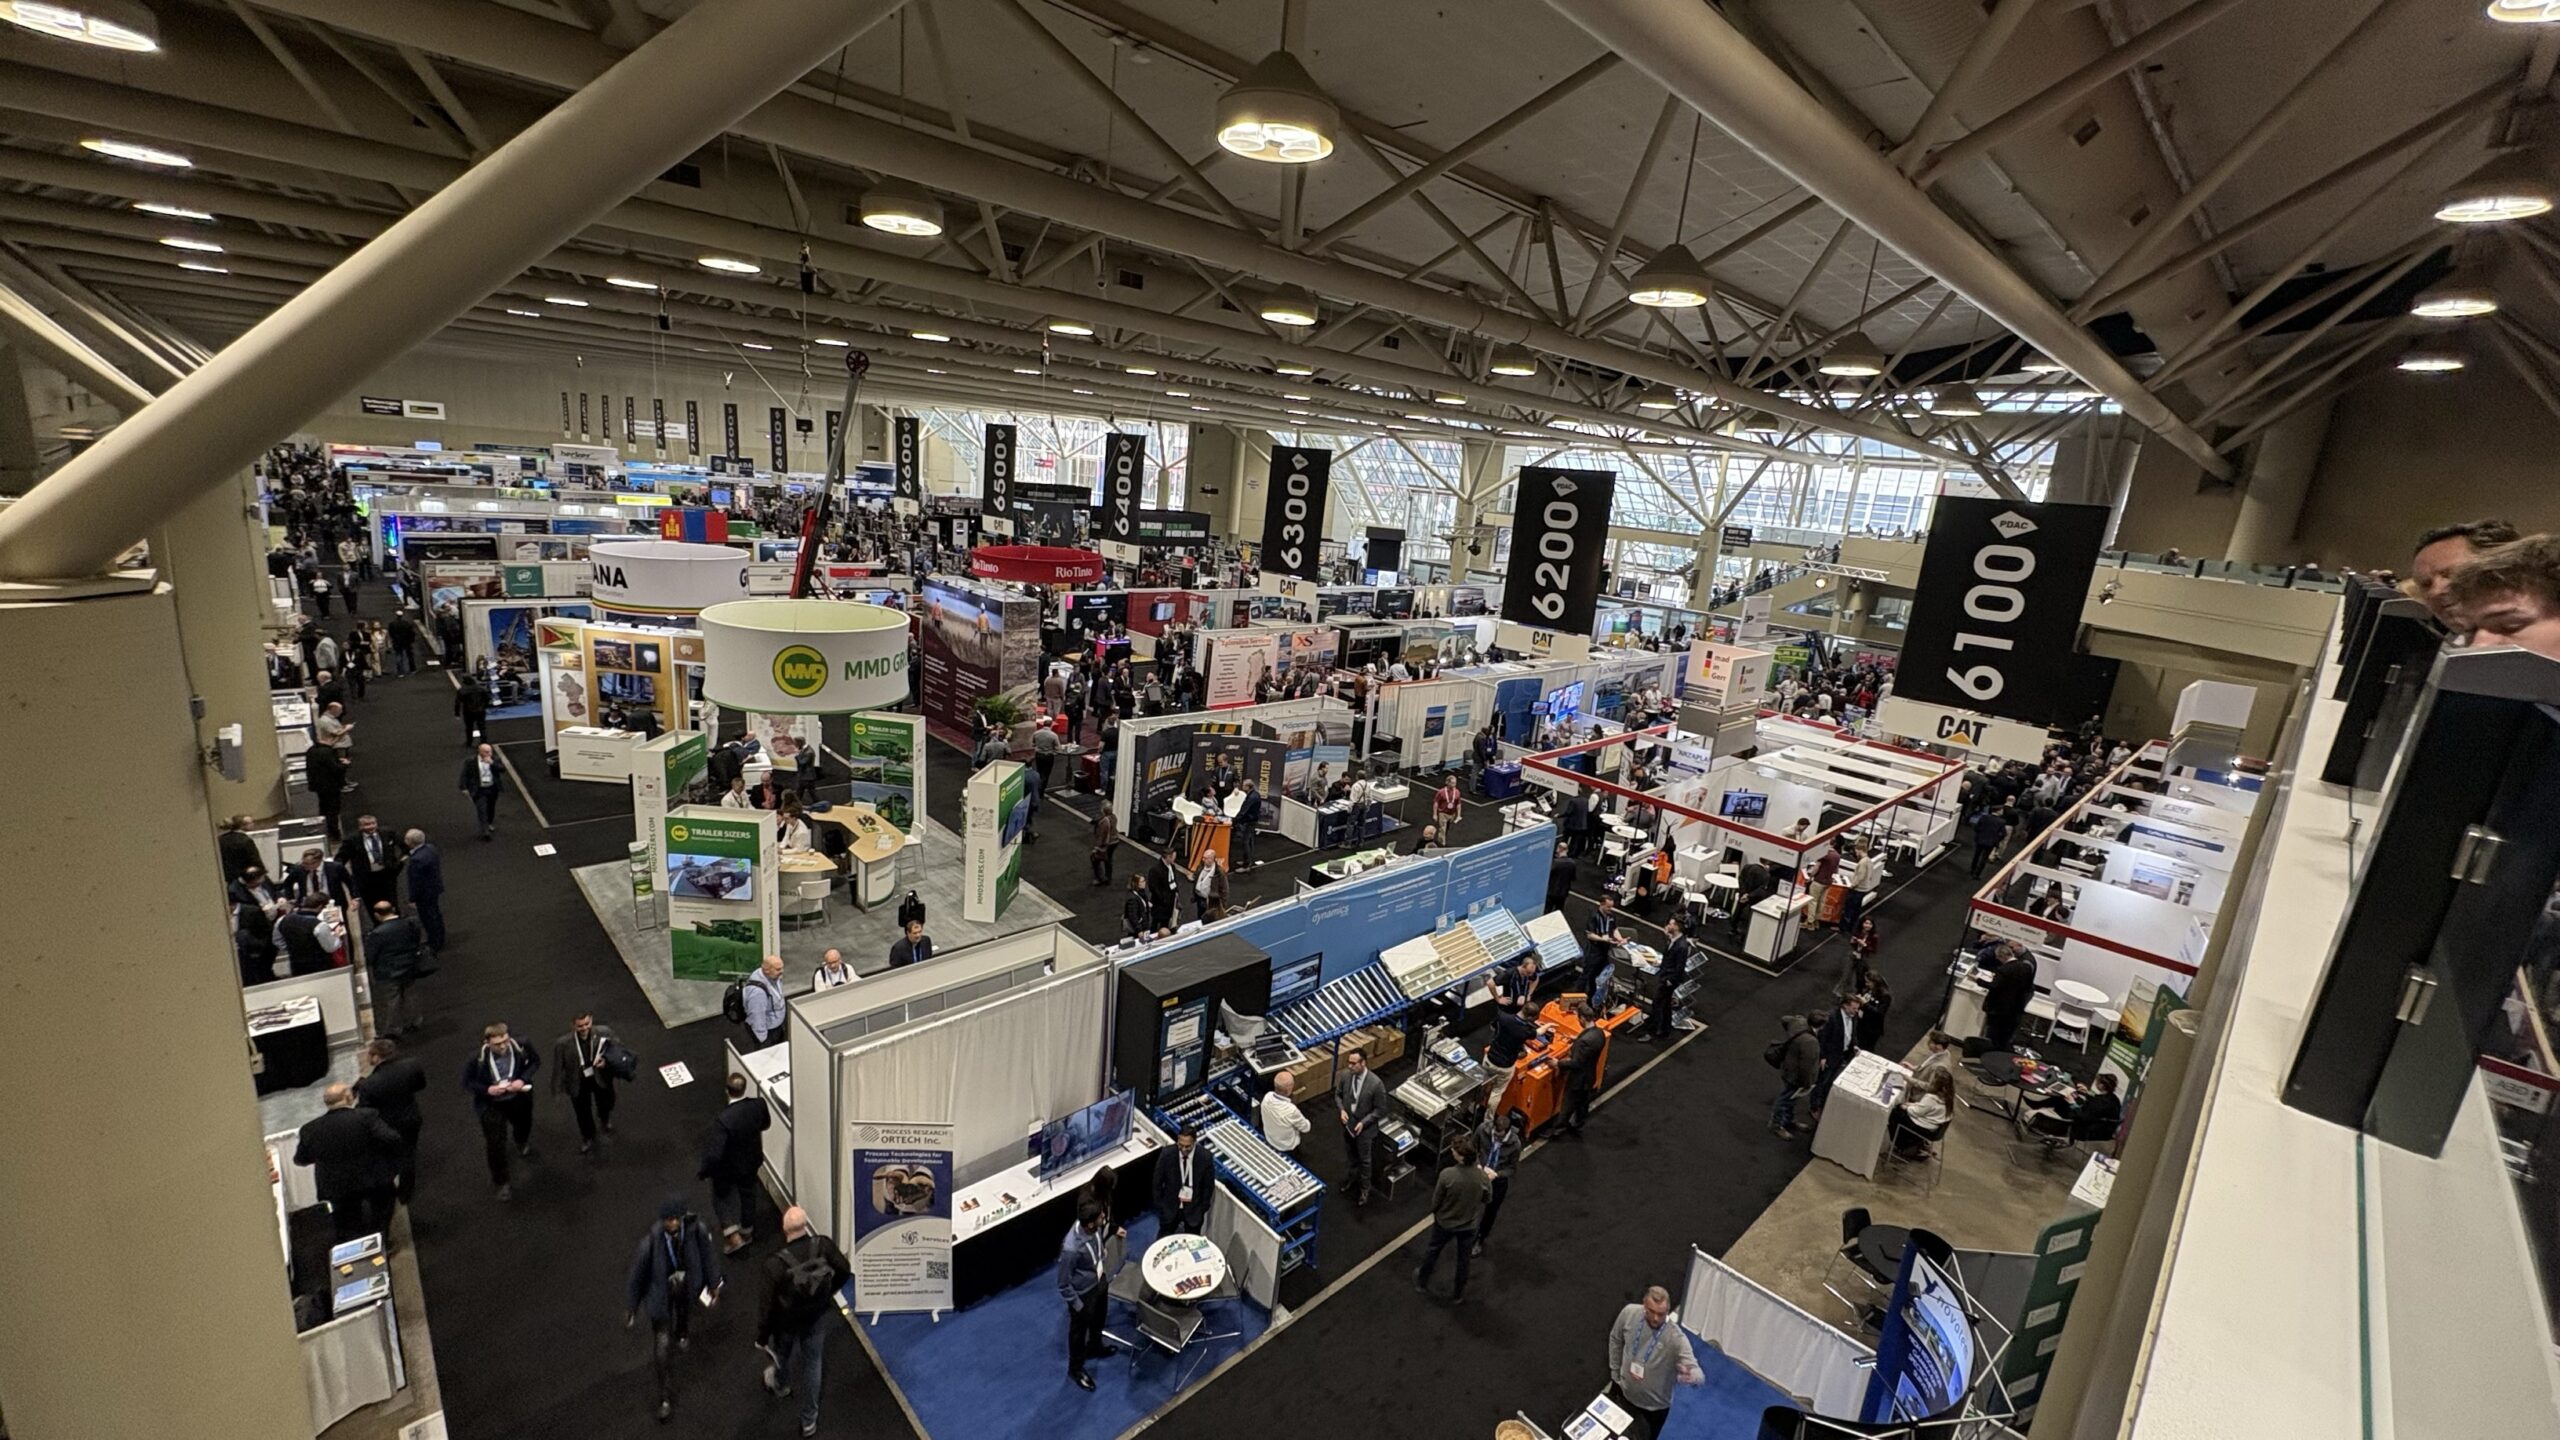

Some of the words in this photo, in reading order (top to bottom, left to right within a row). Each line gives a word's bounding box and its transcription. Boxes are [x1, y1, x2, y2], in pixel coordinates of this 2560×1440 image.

[727, 415, 735, 461] 6900
[775, 420, 783, 470] 6800
[901, 433, 911, 495] 6600
[993, 443, 1007, 512] 6500
[1115, 455, 1132, 536] 6400
[1281, 473, 1309, 569] 6300
[2000, 519, 2028, 531] PDAC
[1532, 501, 1578, 620] 6200
[1280, 579, 1298, 597] CAT
[1946, 544, 2036, 701] 6100
[1532, 631, 1554, 647] CAT
[844, 657, 890, 681] MMD
[868, 725, 888, 733] TRAILER
[1937, 715, 1987, 746] CAT
[1153, 752, 1187, 780] RALLY
[1205, 752, 1216, 772] SAFE
[691, 828, 723, 839] TRAILER
[724, 829, 751, 840] SIZERS
[1982, 915, 2001, 927] GEA
[881, 1136, 921, 1144] ORTECH
[924, 1137, 942, 1145] Inc.
